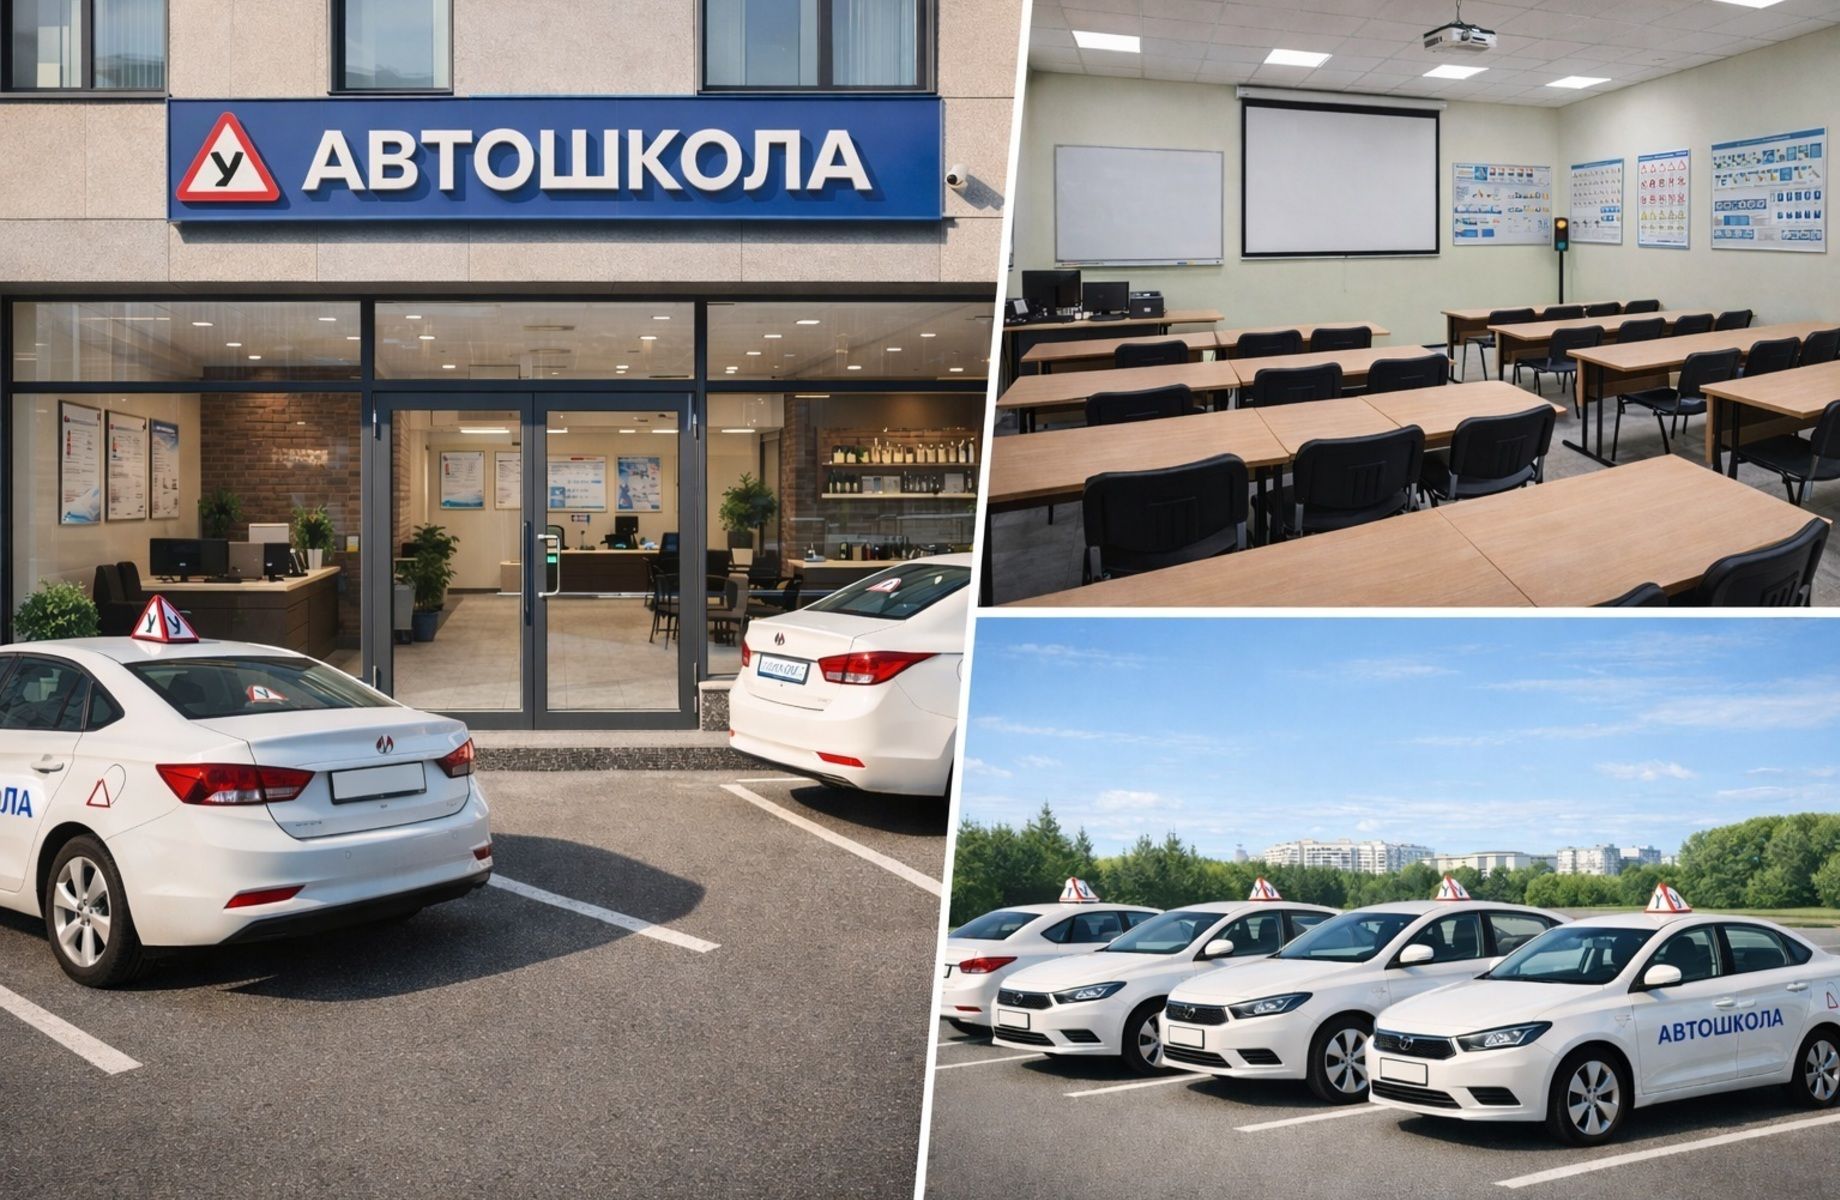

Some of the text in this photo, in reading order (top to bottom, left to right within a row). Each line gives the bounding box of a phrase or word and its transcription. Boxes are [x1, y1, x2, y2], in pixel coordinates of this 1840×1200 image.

[210, 128, 873, 191] У АВТОШКОЛА
[0, 786, 33, 818] ЛА
[1658, 1007, 1784, 1046] АВТОШКОЛА
